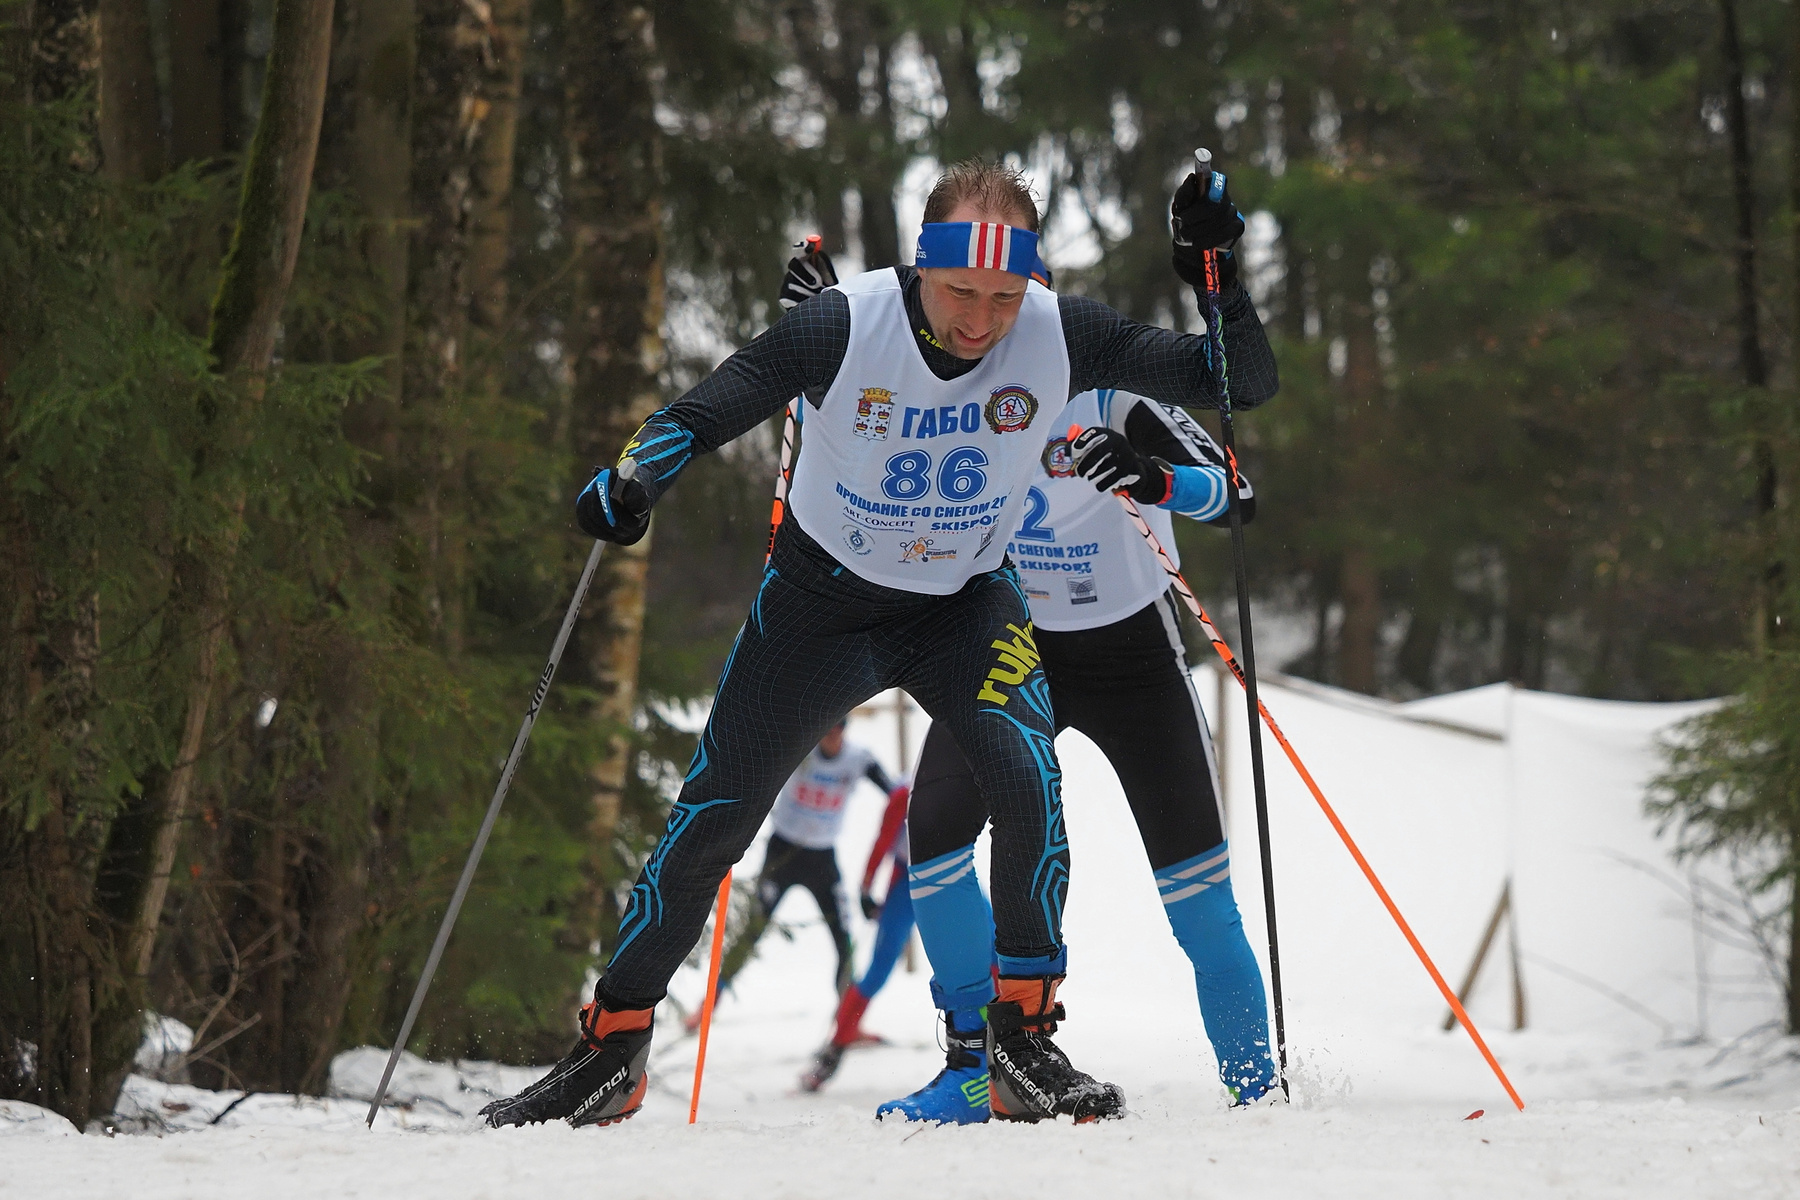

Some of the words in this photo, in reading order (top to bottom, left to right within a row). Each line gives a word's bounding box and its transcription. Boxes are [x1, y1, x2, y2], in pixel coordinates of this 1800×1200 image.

[901, 402, 981, 439] ГАБО
[881, 446, 989, 502] 86
[836, 482, 909, 517] ПРОЩАНИЕ
[911, 506, 931, 517] СО
[934, 502, 990, 518] СНЕГОМ
[843, 506, 916, 527] ART-CONCEPT
[1018, 543, 1065, 558] СНЕГОМ
[1066, 542, 1099, 558] 2022
